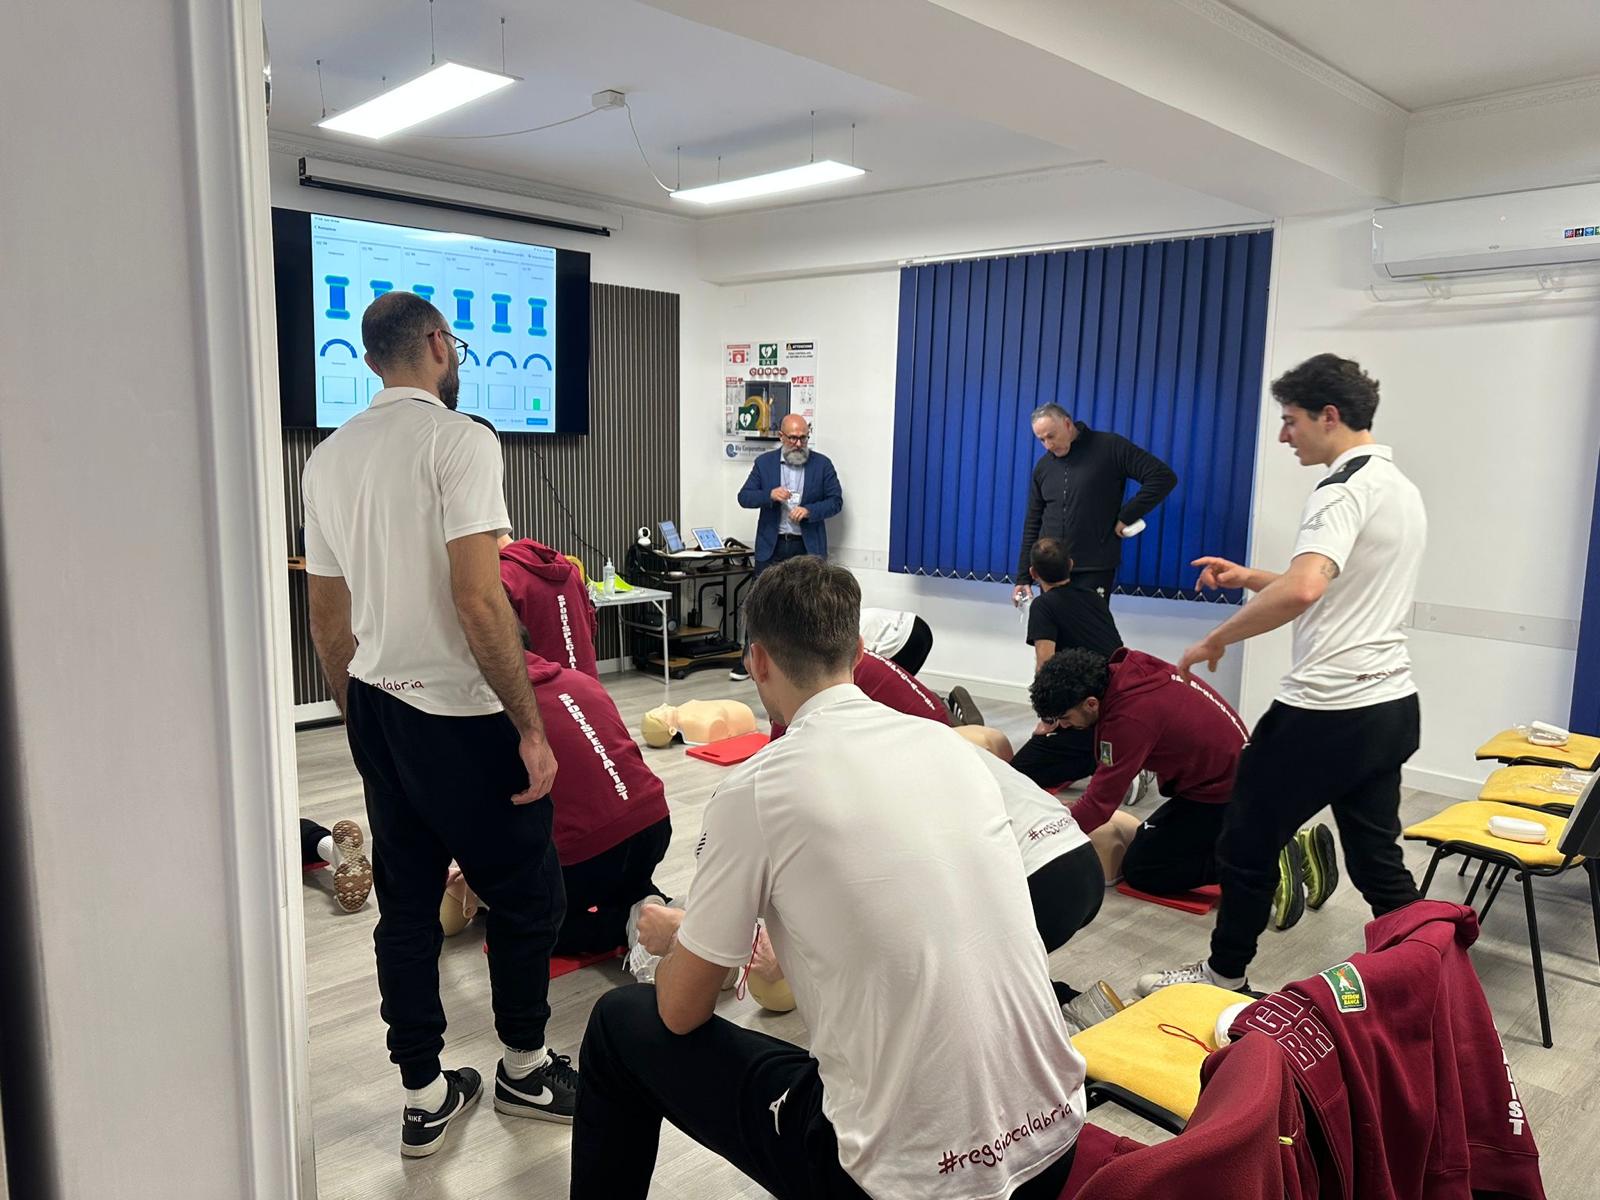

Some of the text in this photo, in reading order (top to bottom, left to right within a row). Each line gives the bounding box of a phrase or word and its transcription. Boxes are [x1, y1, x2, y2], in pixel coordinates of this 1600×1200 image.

[557, 594, 578, 671] SPORTSPECIAL
[407, 1114, 423, 1123] NIKE
[938, 1103, 1073, 1174] #reggiocalabria
